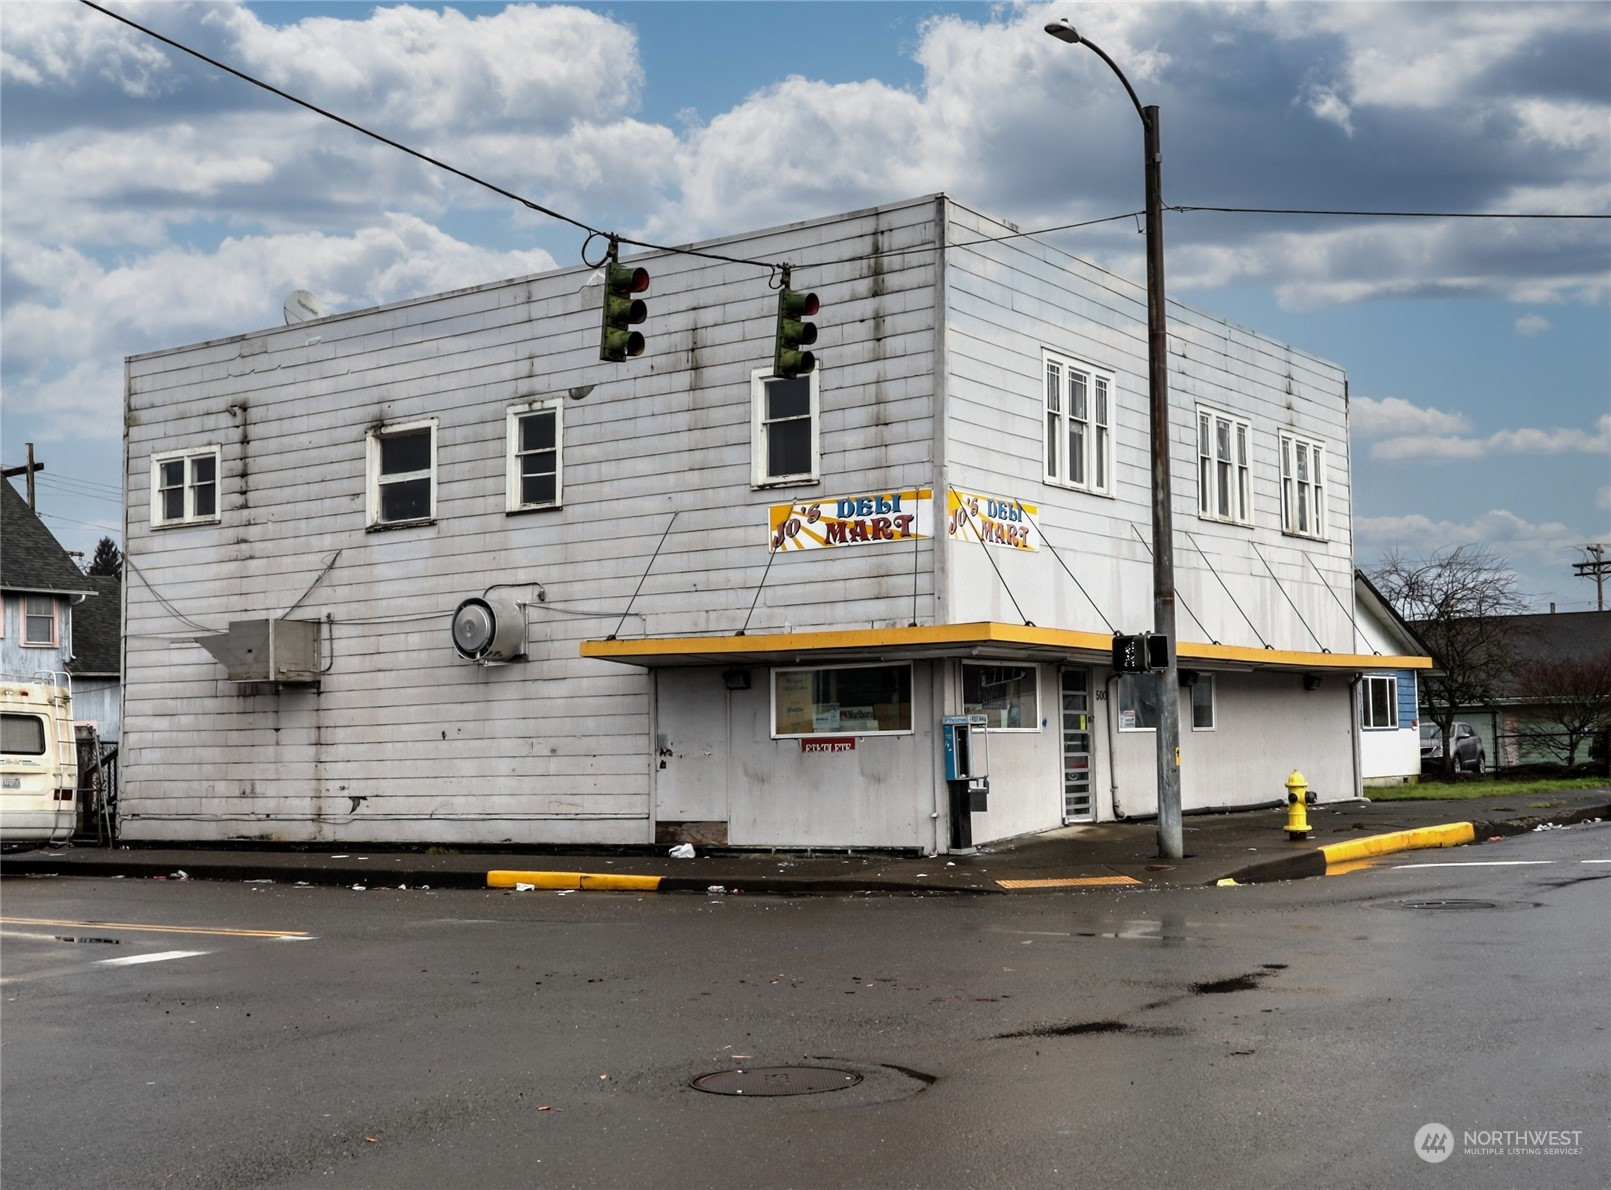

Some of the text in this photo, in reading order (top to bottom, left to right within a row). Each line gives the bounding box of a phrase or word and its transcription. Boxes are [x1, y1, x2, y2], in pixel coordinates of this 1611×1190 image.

[772, 494, 902, 548] JO'S DELI
[825, 514, 914, 545] MART
[949, 497, 1023, 535] JO'S DELI
[980, 520, 1029, 548] MART
[1095, 690, 1107, 701] 500
[847, 709, 874, 719] Marlboro
